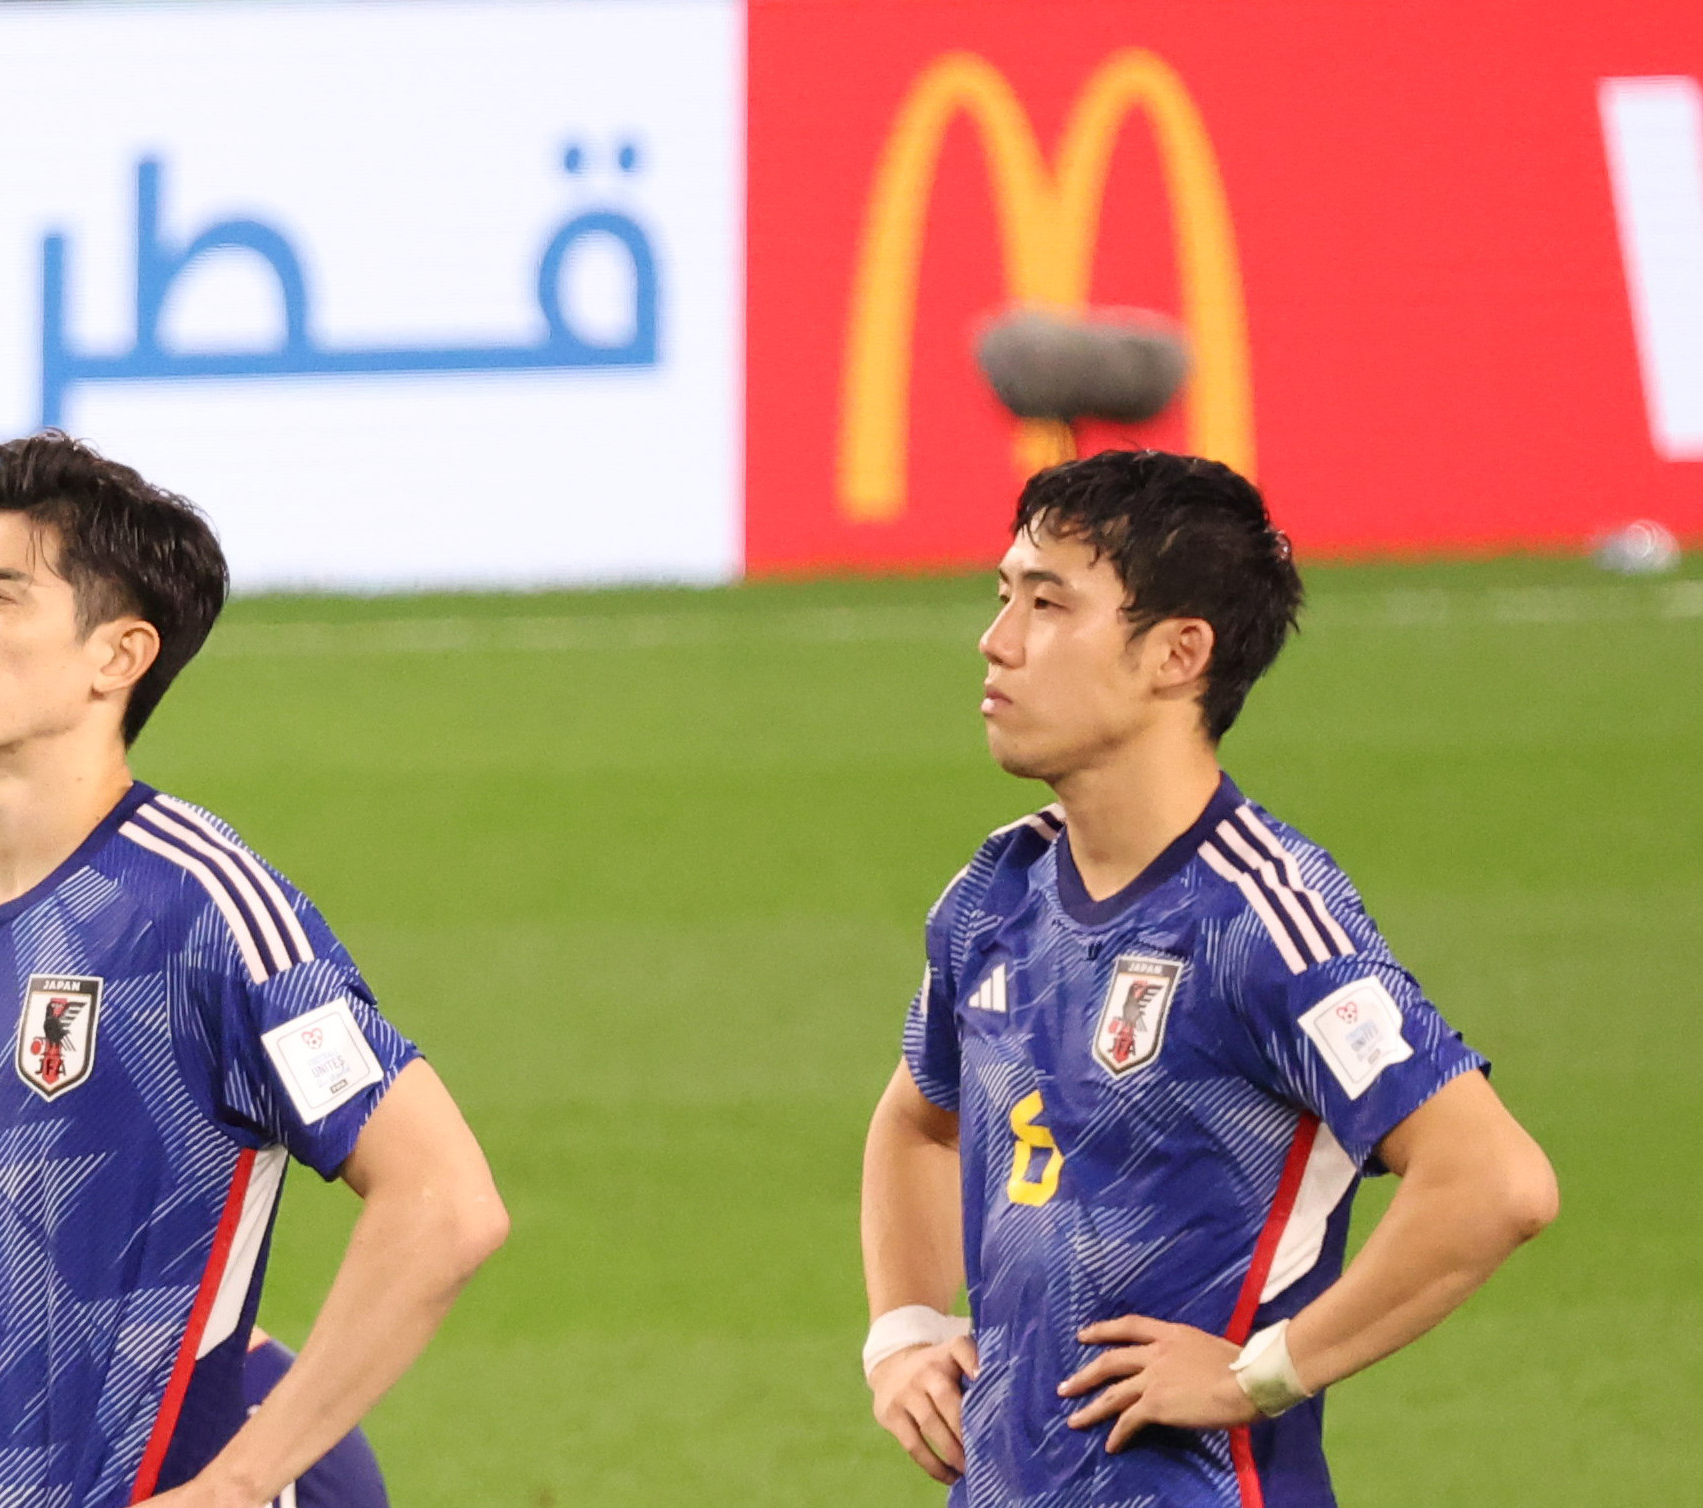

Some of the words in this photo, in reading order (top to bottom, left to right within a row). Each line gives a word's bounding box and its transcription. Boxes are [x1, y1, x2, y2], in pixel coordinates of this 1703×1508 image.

[39, 133, 660, 432] قطر
[43, 980, 81, 991] JAPAN
[34, 1057, 67, 1076] JFA
[1007, 1089, 1065, 1207] 6
